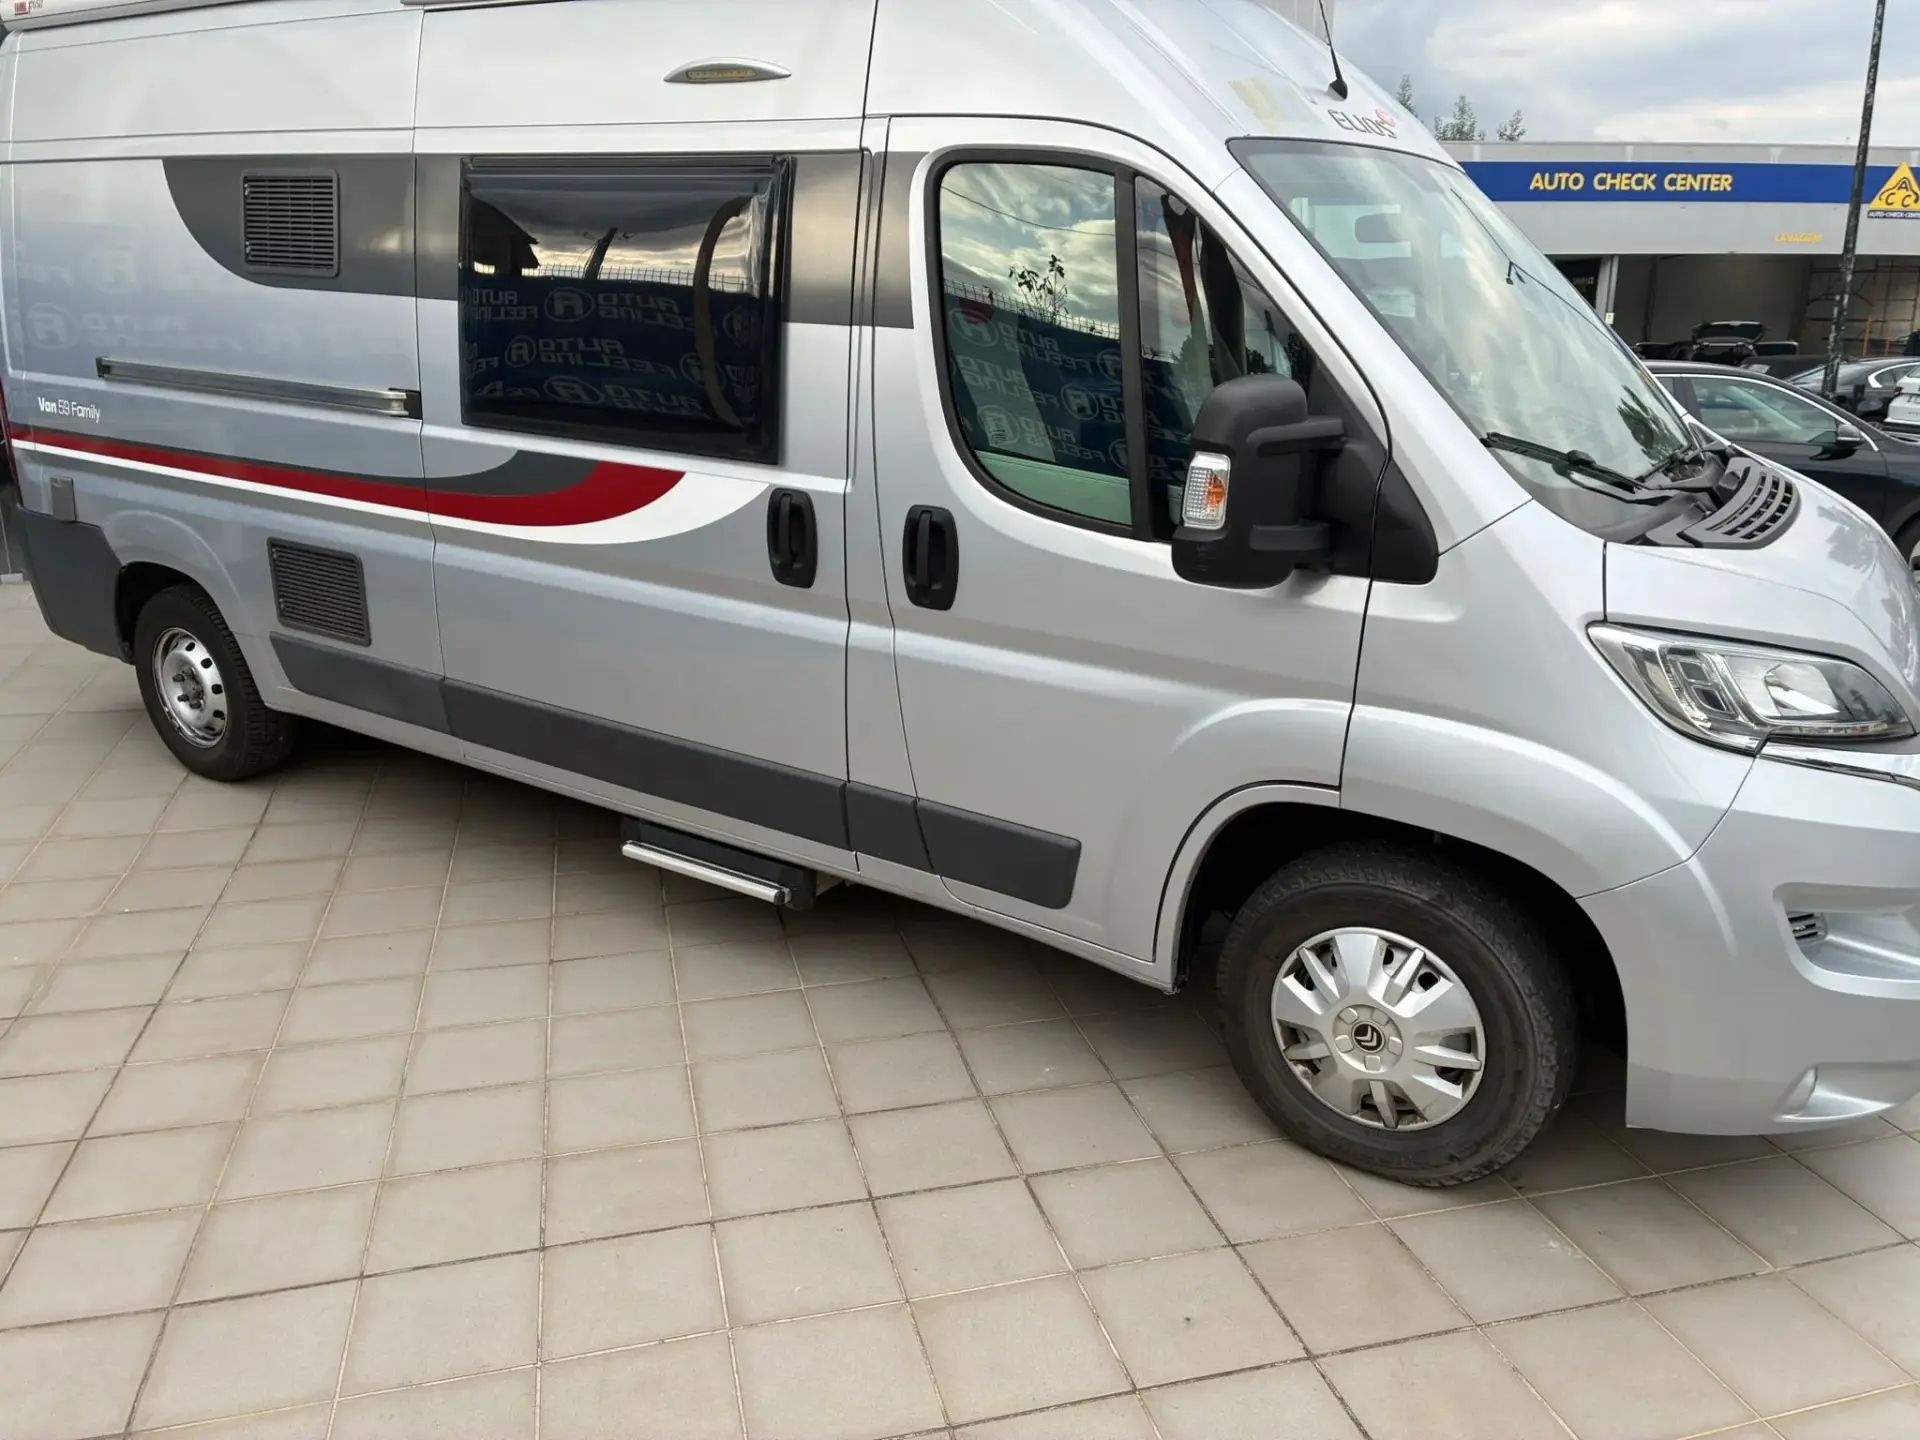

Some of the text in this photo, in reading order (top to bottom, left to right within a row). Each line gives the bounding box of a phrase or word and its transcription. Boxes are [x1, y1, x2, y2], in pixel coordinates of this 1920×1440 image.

[1328, 109, 1398, 139] ELIOS
[1529, 172, 1733, 192] AUTO CHECK CENTER
[38, 397, 101, 423] Van 59 Family
